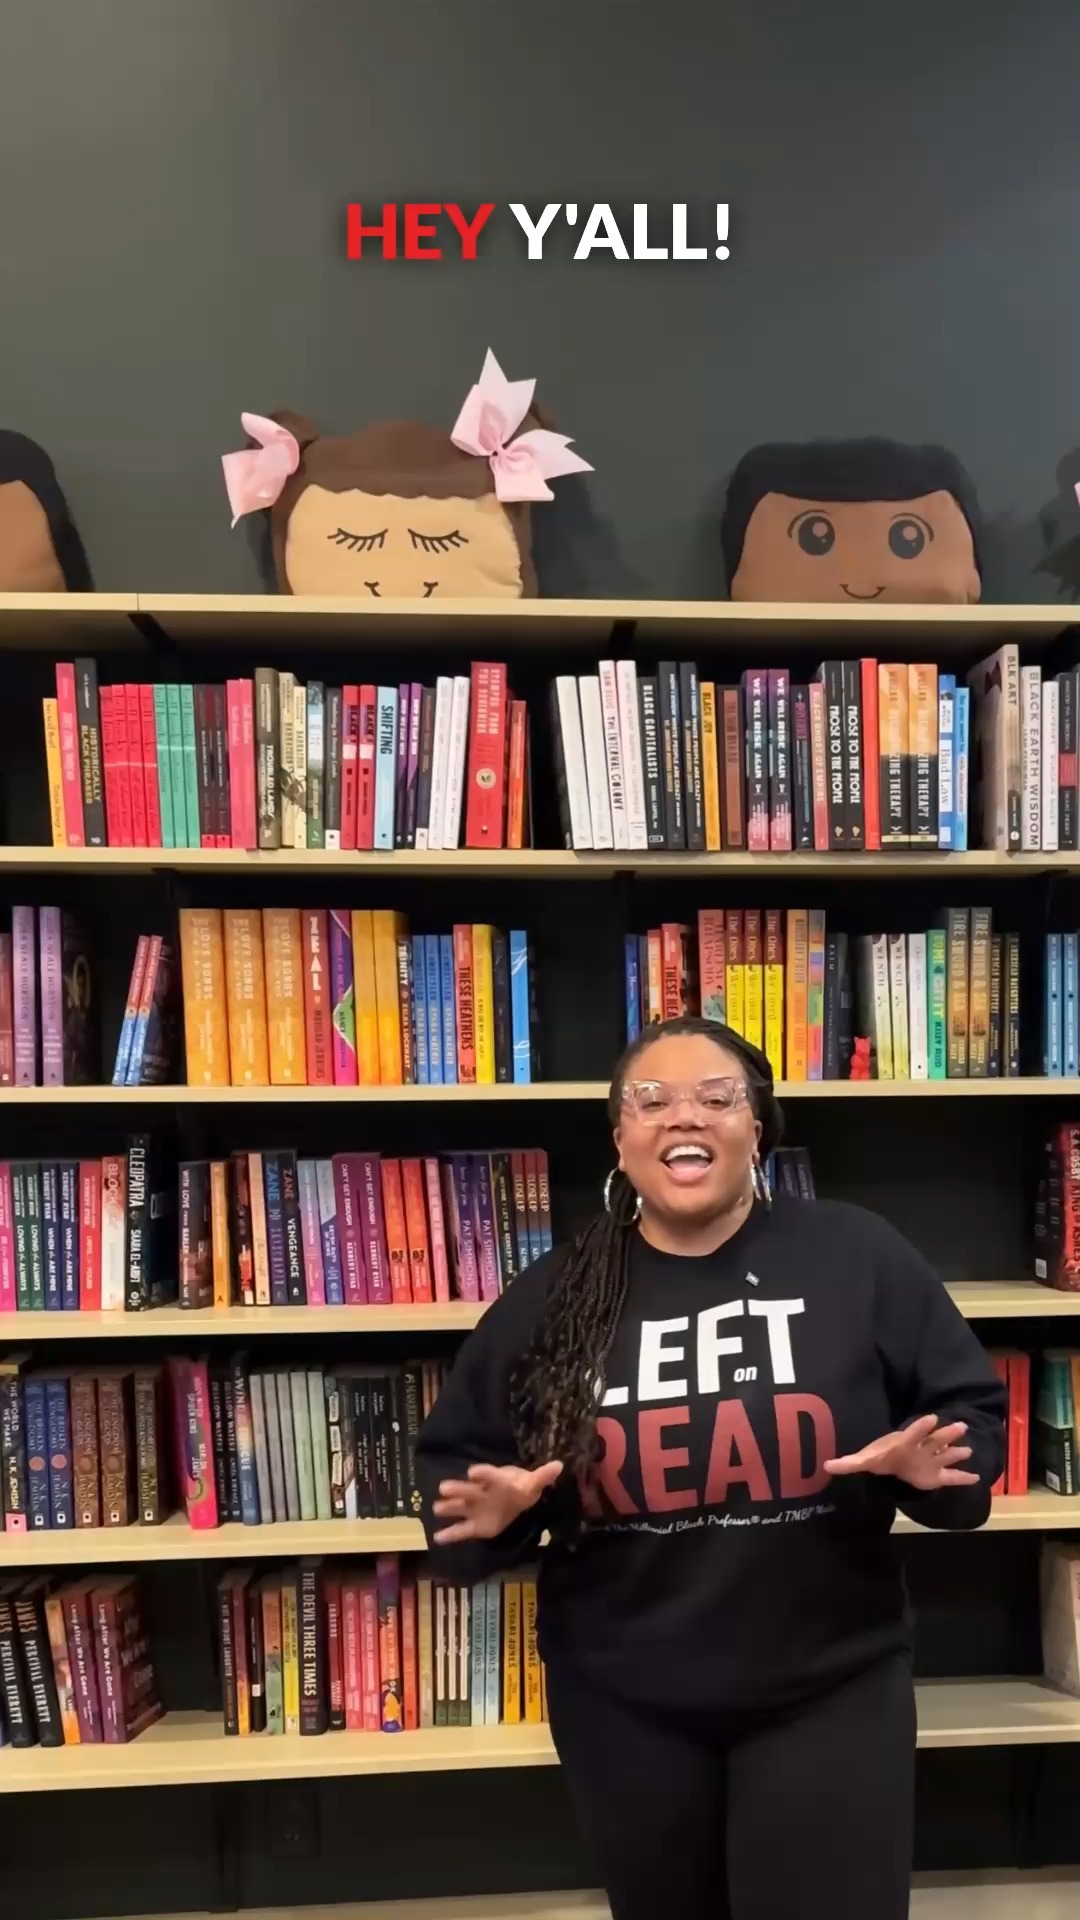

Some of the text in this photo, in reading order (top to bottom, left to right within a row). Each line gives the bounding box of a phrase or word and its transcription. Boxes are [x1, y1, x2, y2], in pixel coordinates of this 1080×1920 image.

[1007, 656, 1016, 706] BLK ART
[81, 725, 90, 757] BLACK
[380, 705, 393, 754] SHIFTING
[643, 685, 658, 779] BLACK CAPITALISTS
[753, 678, 762, 778] WE WILL AGAIN
[777, 677, 786, 778] WE WILL AGAIN
[90, 728, 100, 802] HISTORICALLY
[266, 744, 274, 788] TROUBLED
[830, 706, 843, 804] PROSE TO THE PEOPLE
[847, 706, 860, 804] PROSE TO THE PEOPLE
[940, 749, 952, 805] Bad Law
[1029, 672, 1039, 846] BLACK EARTH WISDOM
[889, 779, 902, 818] THERAPY
[918, 779, 929, 818] THERAPY
[953, 914, 966, 937] FIRE
[975, 913, 988, 936] FIRE
[398, 944, 408, 985] TRINITY
[665, 966, 677, 996] THESE
[459, 967, 473, 1050] THESE HEATHENS
[108, 1163, 119, 1204] BLOCK
[129, 1147, 145, 1252] CLEOPATRA SAARA
[266, 1162, 280, 1201] ZANE
[283, 1168, 299, 1278] ZANE VENGEANCE
[344, 1198, 352, 1226] ENOUGH
[462, 1220, 475, 1287] PAT SIMMONS
[482, 1220, 496, 1286] PAT SIMMONS
[733, 1366, 758, 1383] on
[11, 1400, 19, 1431] WORLD
[577, 1393, 837, 1515] READ
[761, 1514, 782, 1525] and
[74, 1625, 83, 1645] After
[77, 1647, 84, 1659] We
[100, 1625, 108, 1645] After
[103, 1647, 110, 1660] We
[302, 1572, 316, 1696] THE DEVIL THREE TIMES
[0, 1640, 22, 1723] PERCIVAL EVERETT
[24, 1640, 43, 1681] PERCIVAL
[36, 1684, 51, 1723] EVERETT
[106, 1676, 114, 1696] Gone
